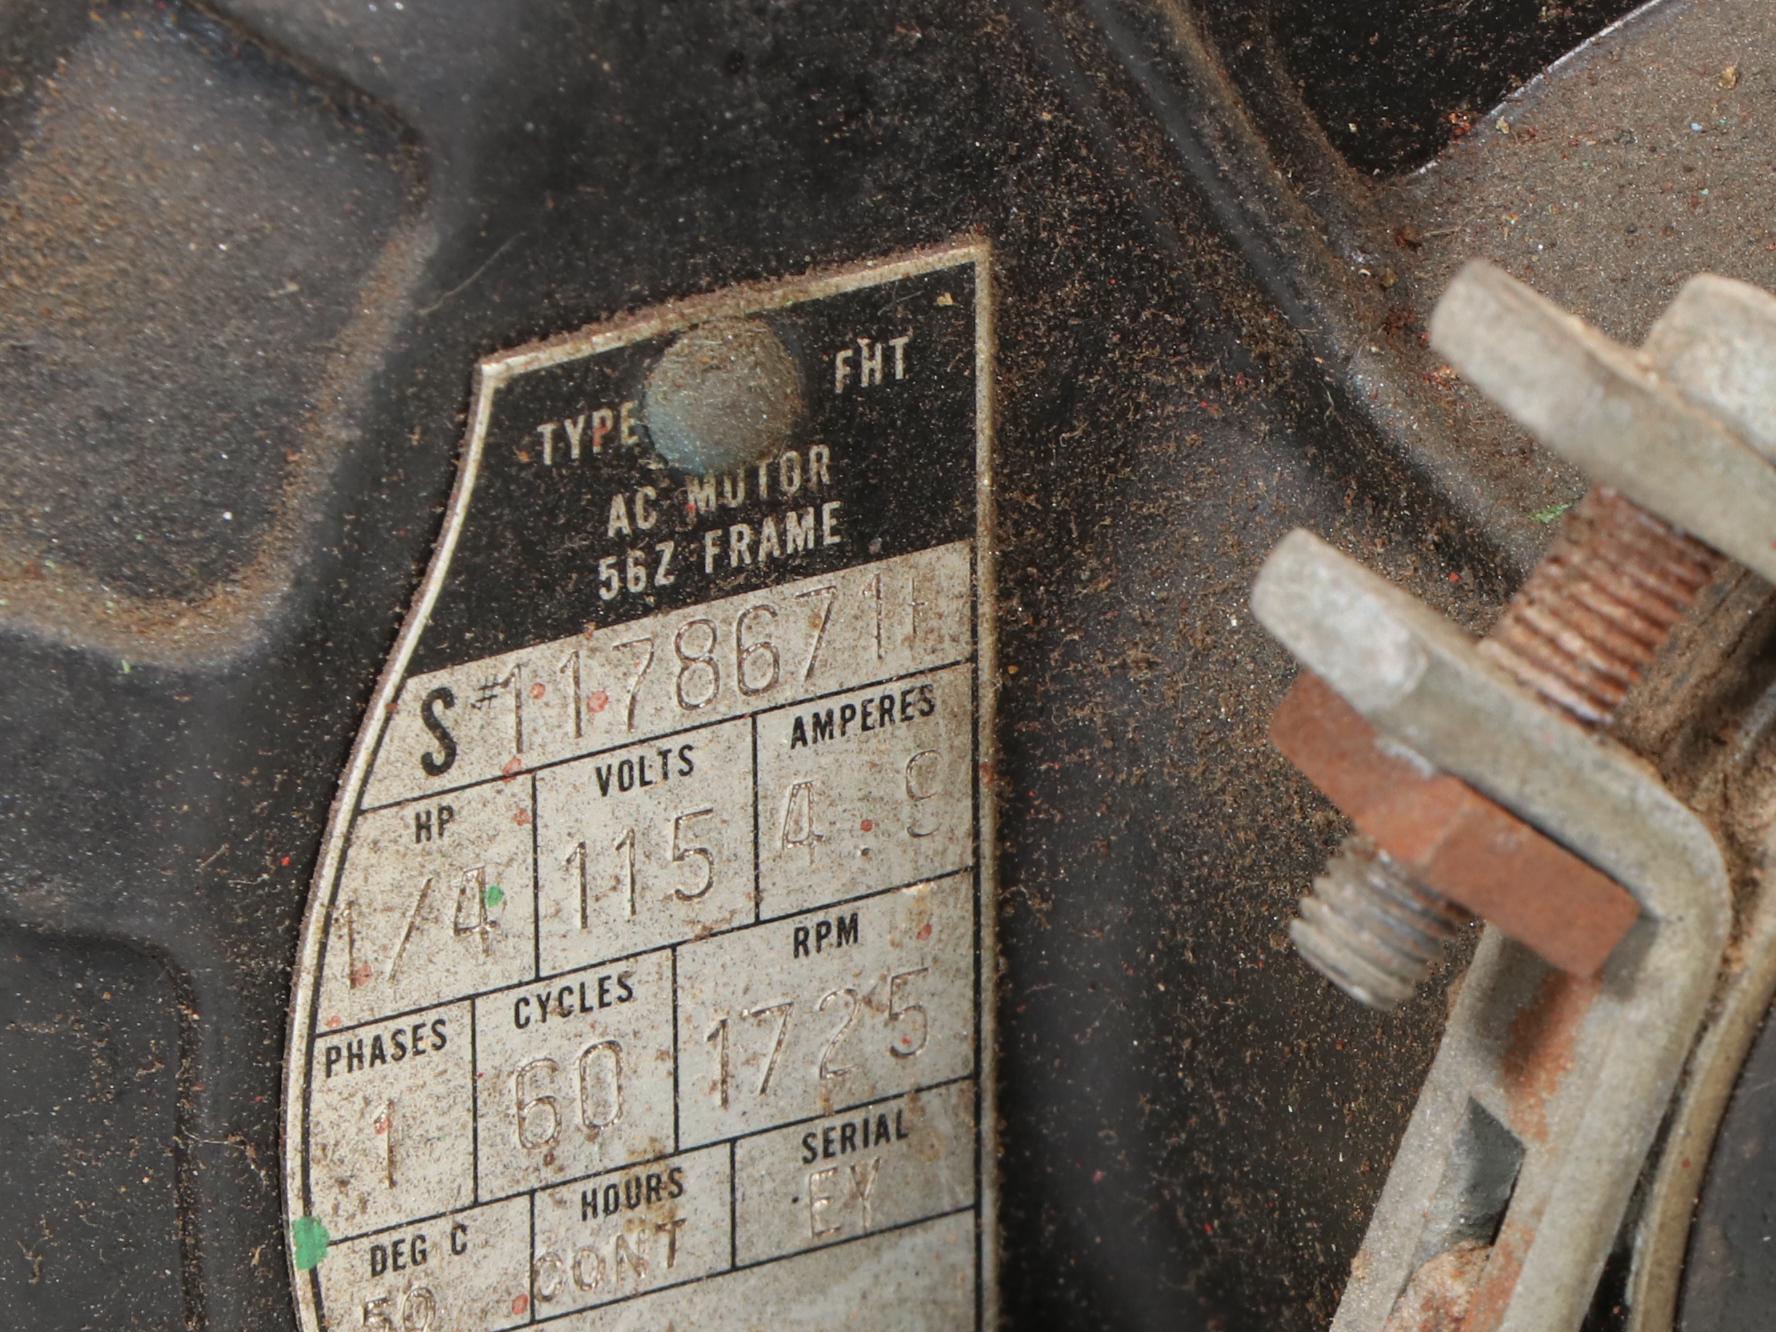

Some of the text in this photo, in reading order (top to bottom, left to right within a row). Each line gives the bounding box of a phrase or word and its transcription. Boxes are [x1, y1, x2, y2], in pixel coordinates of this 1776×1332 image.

[536, 335, 911, 466] TYPE FHT
[607, 443, 831, 538] AC MOTOR
[598, 501, 842, 601] 56Z FRAME
[421, 687, 457, 776] S
[790, 683, 936, 750] AMPERES
[594, 744, 696, 798] VOLTS
[413, 803, 456, 845] HP
[563, 808, 716, 930] 115
[341, 864, 500, 990] 1/4
[792, 913, 861, 960] RPM
[512, 972, 635, 1031] CYCLES
[705, 966, 930, 1109] 1725
[324, 1018, 450, 1078] PHASES
[514, 1038, 627, 1152] 60
[801, 1107, 910, 1165] SERIAL
[374, 1098, 397, 1190] 1
[580, 1167, 686, 1222] HOURS
[808, 1155, 882, 1239] EY
[370, 1222, 468, 1278] DEG C
[533, 1217, 688, 1302] CONT
